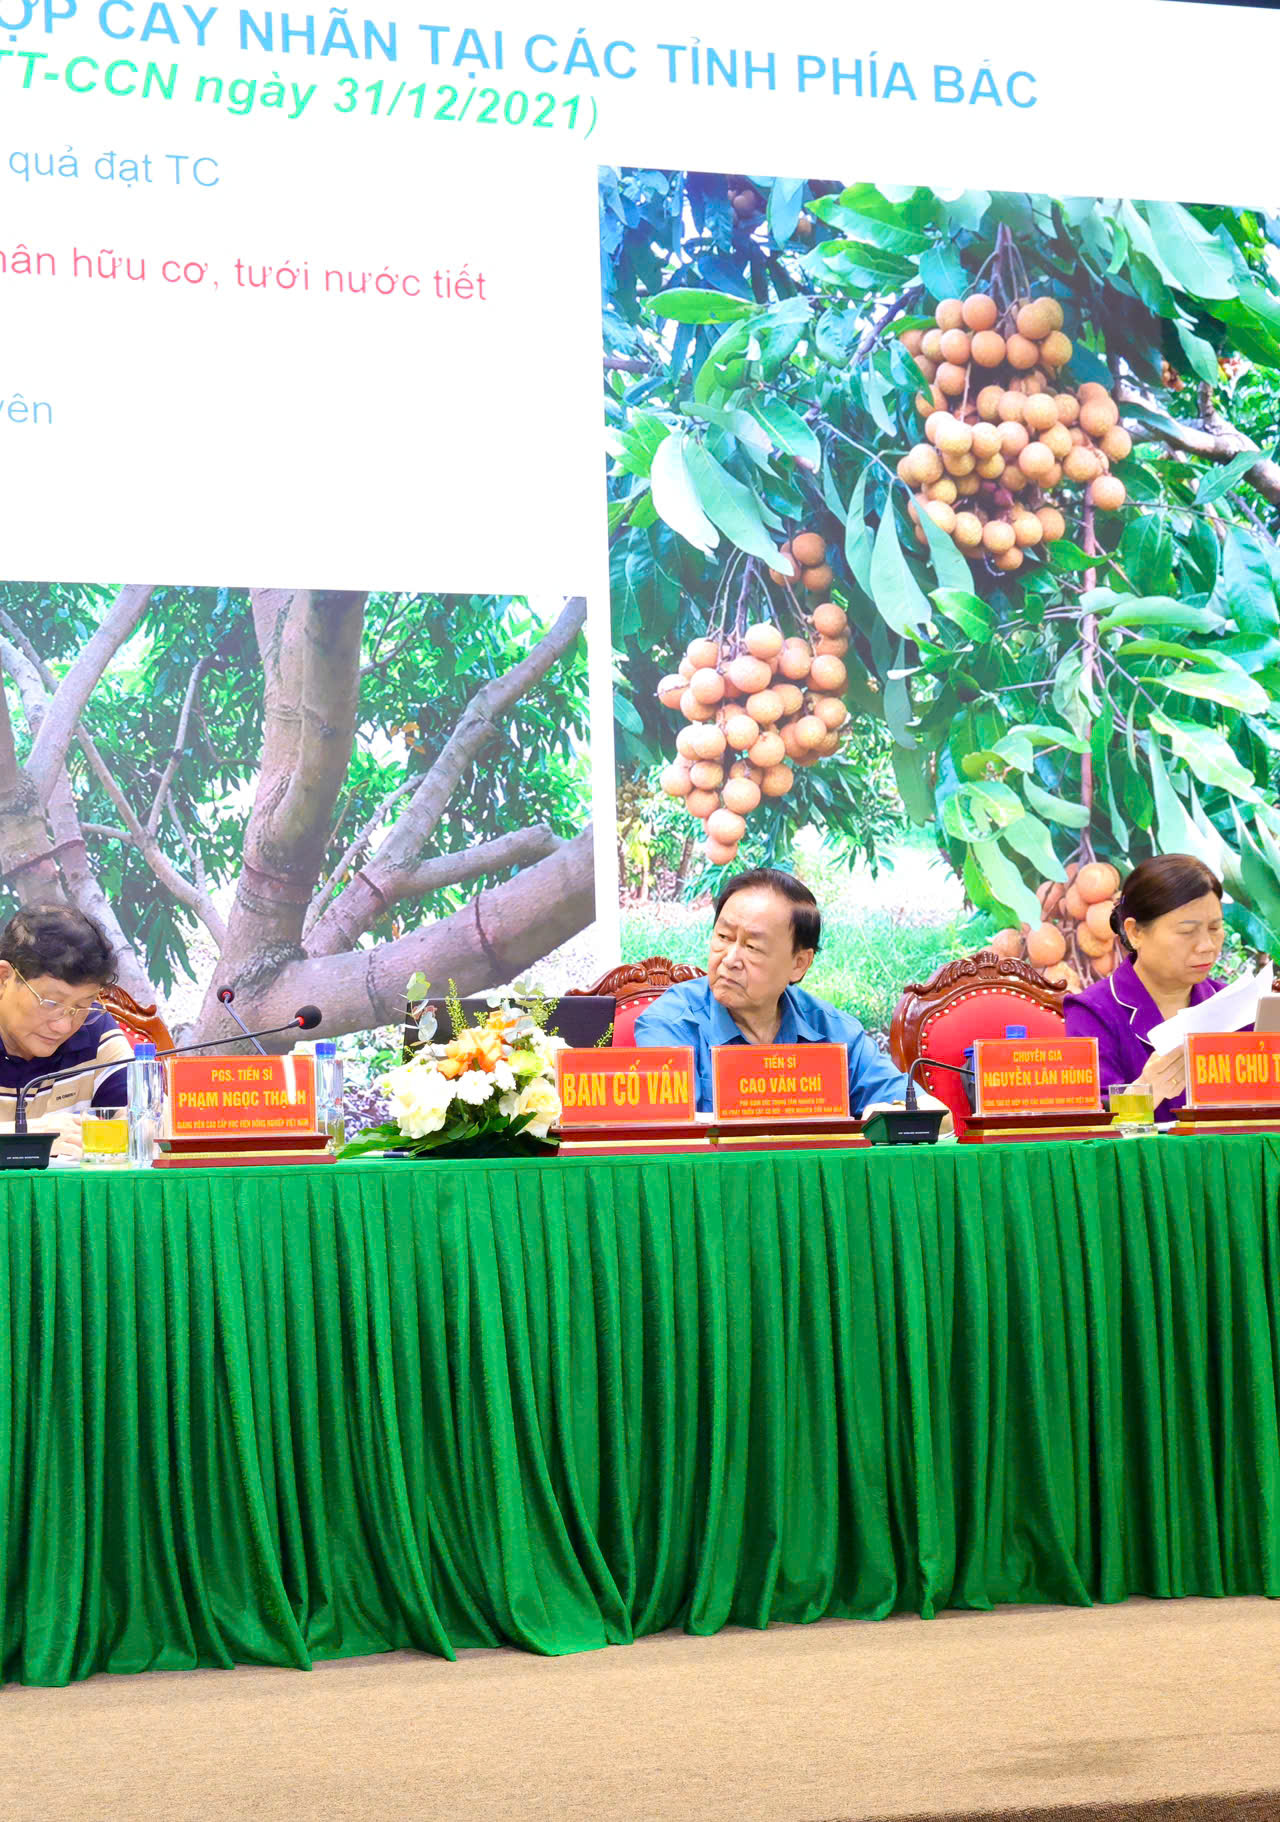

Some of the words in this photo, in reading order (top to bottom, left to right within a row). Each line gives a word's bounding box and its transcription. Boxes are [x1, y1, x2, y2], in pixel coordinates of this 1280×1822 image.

[240, 8, 397, 62] NHÃN
[419, 24, 504, 79] TẠI
[525, 27, 637, 80] CÁC
[656, 37, 776, 91] TỈNH
[798, 51, 918, 101] PHÍA
[934, 60, 1037, 108] BẮC
[195, 72, 318, 119] ngày
[333, 77, 598, 140] 31/12/2021)
[9, 146, 78, 182] quả
[96, 152, 152, 188] đạt
[166, 154, 219, 187] TC
[74, 248, 145, 280] hữu
[162, 261, 218, 288] cơ,
[234, 258, 308, 290] tưới
[326, 266, 420, 296] nước
[434, 264, 486, 300] tiết
[763, 1053, 785, 1069] TIẾN
[1013, 1049, 1046, 1062] CHUYÊN
[1048, 1050, 1062, 1061] GIA
[1196, 1054, 1231, 1084] BAN
[1236, 1041, 1268, 1084] CHỦ
[211, 1069, 234, 1082] PGS.
[238, 1065, 260, 1081] TIẾN
[563, 1073, 606, 1107] BAN
[613, 1059, 640, 1106] CỐ
[647, 1059, 688, 1105] VẤN
[739, 1077, 766, 1094] CAO
[770, 1074, 796, 1093] VĂN
[799, 1073, 822, 1092] CHÍ
[984, 1066, 1031, 1087] NGUYỄN
[1035, 1067, 1058, 1085] LÂN
[1062, 1066, 1093, 1085] HÙNG
[178, 1092, 218, 1110] PHẠM
[222, 1091, 259, 1109] NGỌC
[264, 1090, 306, 1108] THẠH
